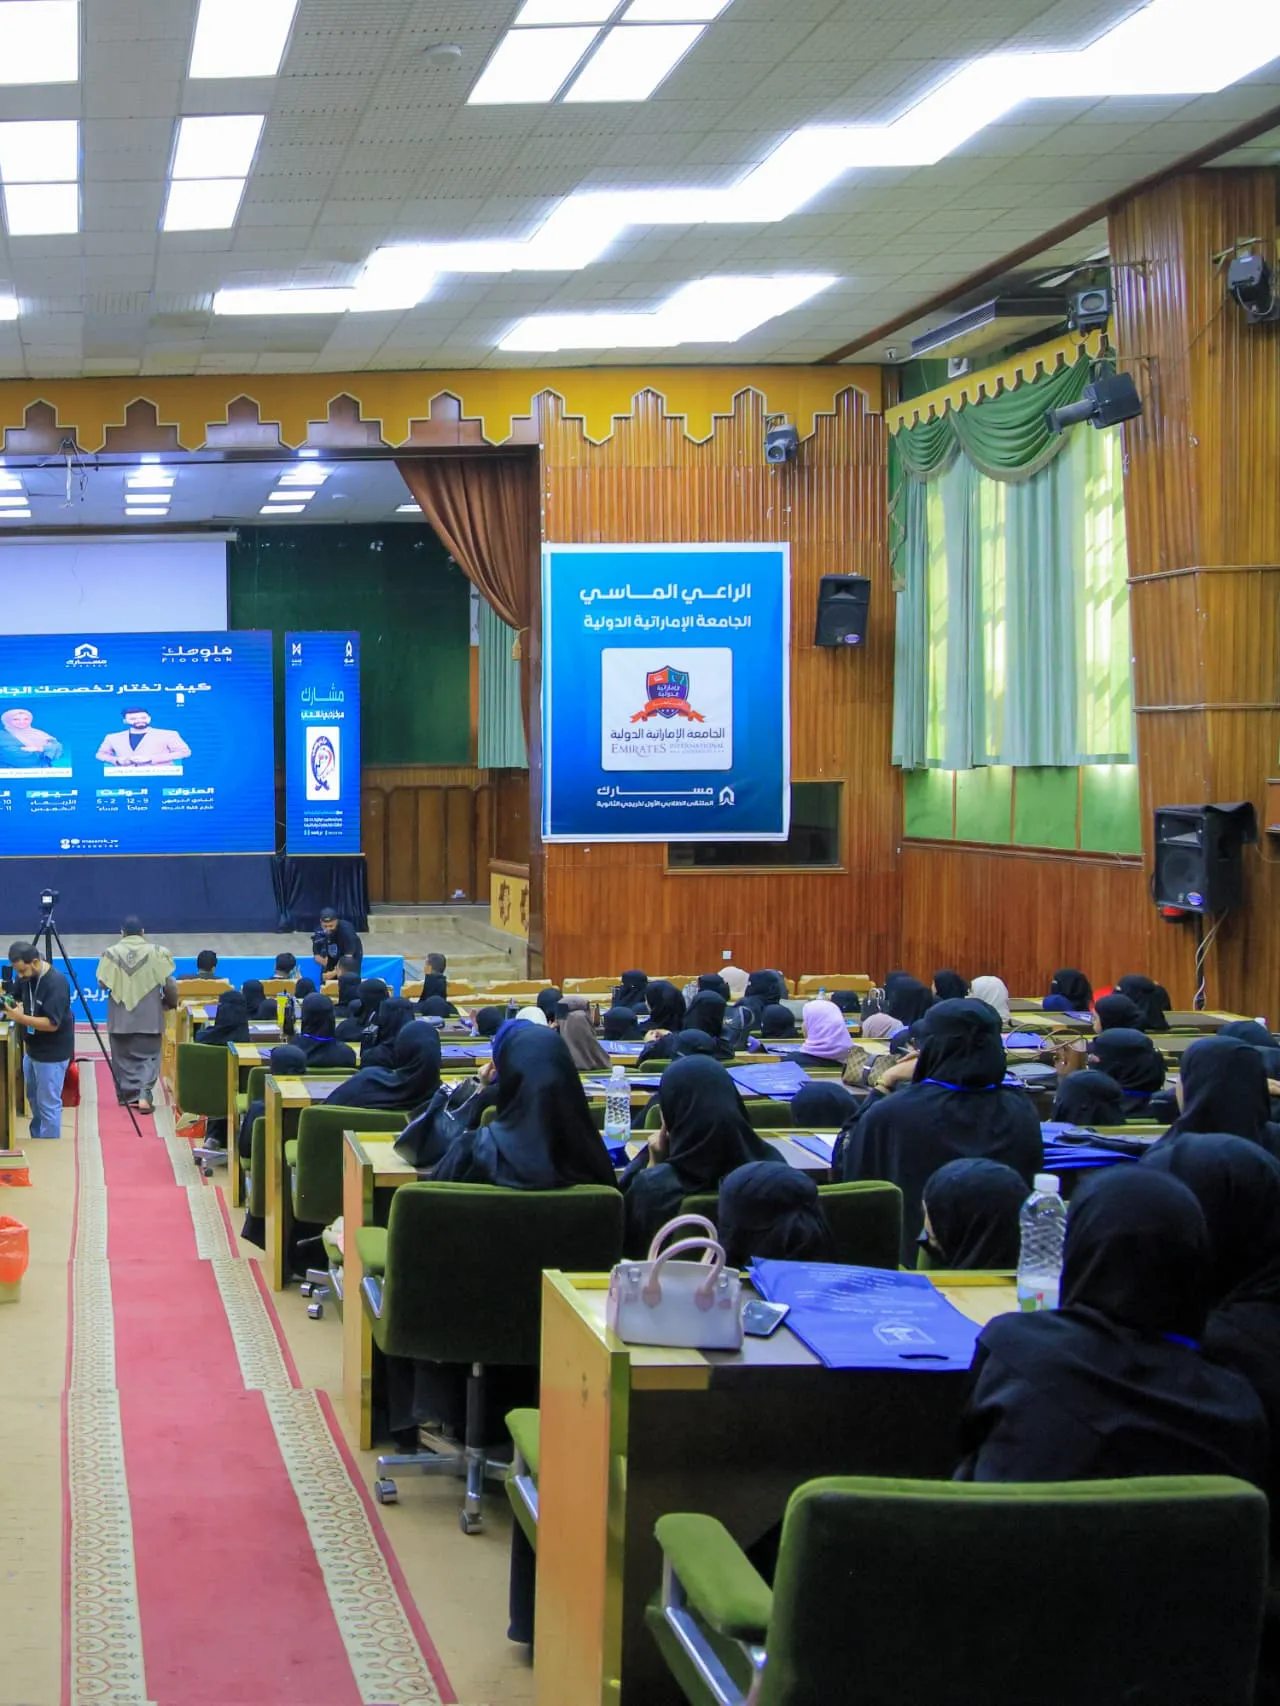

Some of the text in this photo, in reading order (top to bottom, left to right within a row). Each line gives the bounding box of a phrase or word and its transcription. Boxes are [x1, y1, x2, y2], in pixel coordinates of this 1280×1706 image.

[579, 583, 751, 605] الراعي الماسي
[583, 614, 752, 632] الجامعة الإماراتية الدولية
[34, 684, 114, 694] تخصصك
[116, 683, 162, 695] تختار
[164, 682, 212, 694] كيف
[610, 728, 725, 742] الجامعة الإماراتية الدولية
[611, 743, 667, 757] EMIRATES
[597, 785, 714, 798] مسارك
